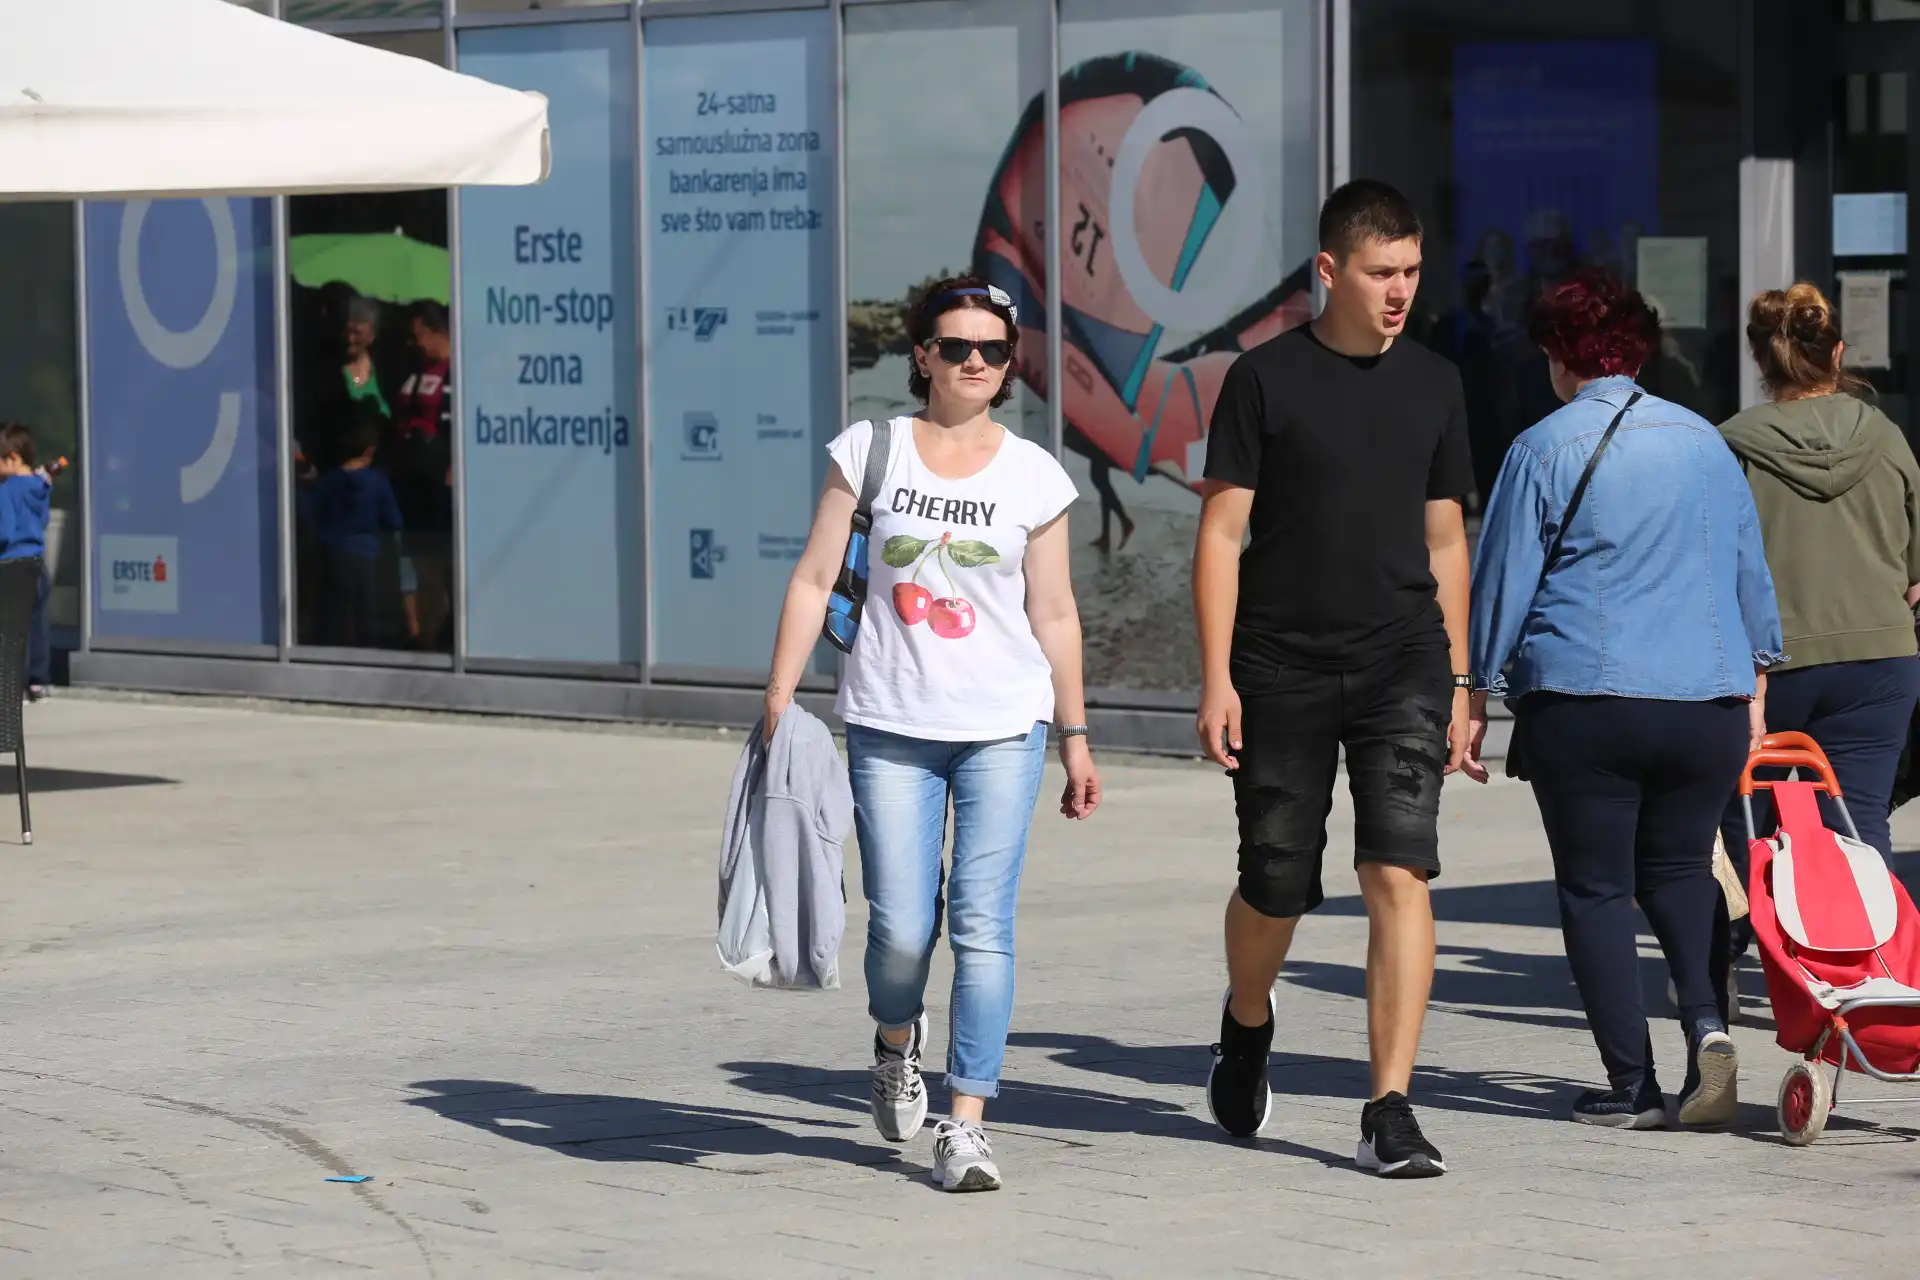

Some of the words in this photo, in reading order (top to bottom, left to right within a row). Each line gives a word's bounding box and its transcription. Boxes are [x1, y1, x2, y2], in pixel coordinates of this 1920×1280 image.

[697, 91, 776, 116] 24-satna
[656, 128, 772, 156] samouslužna
[777, 131, 820, 152] zona
[669, 166, 768, 197] bankarenja
[772, 165, 807, 192] ima
[660, 212, 691, 233] sve
[695, 206, 723, 232] što
[726, 211, 765, 232] vam
[770, 204, 822, 231] treba:
[514, 225, 582, 264] Erste
[486, 285, 614, 333] Non-stop
[518, 353, 583, 385] zona
[476, 404, 629, 456] bankarenja
[891, 487, 996, 527] CHERRY
[113, 559, 152, 582] ERSTE
